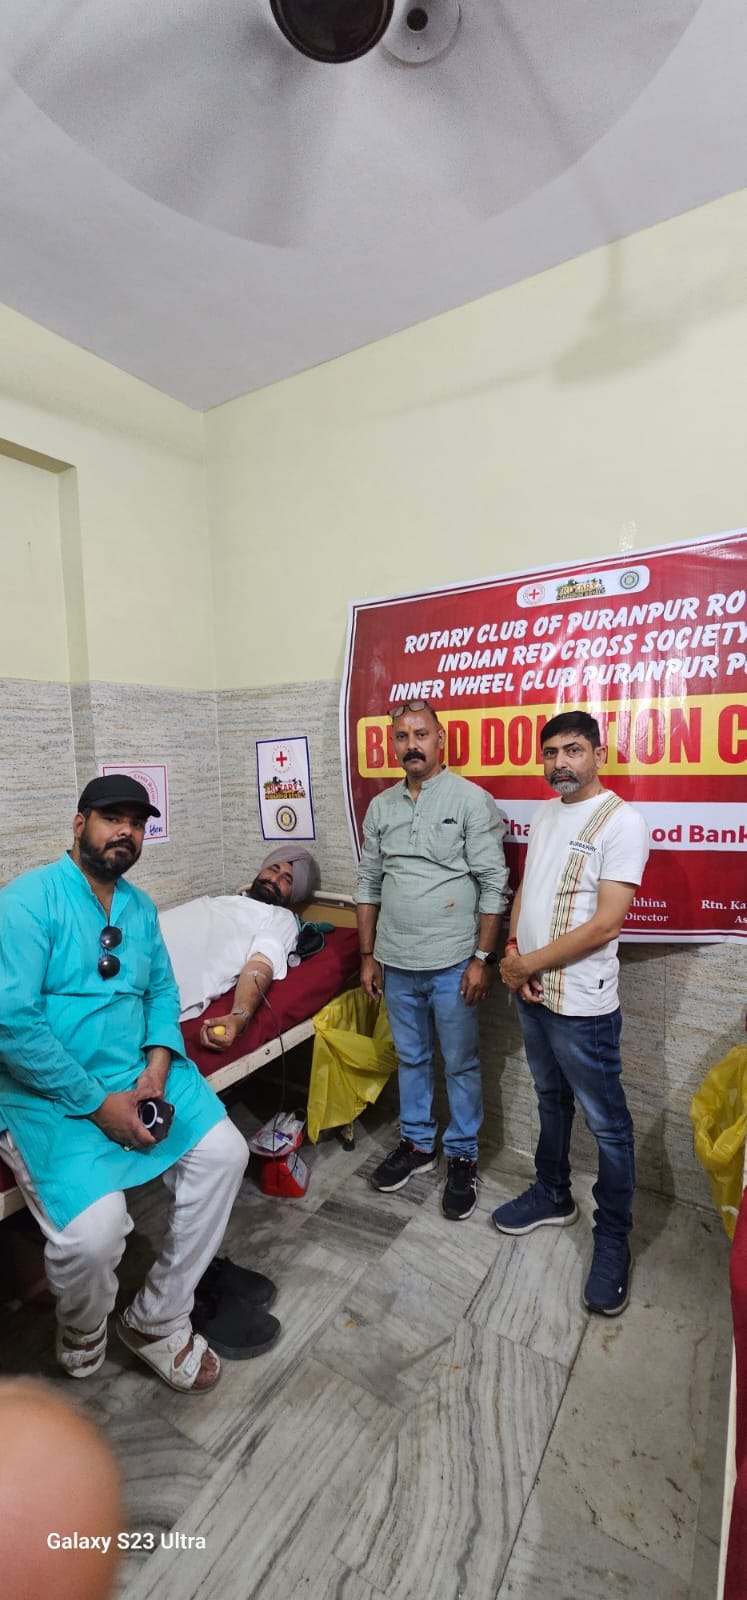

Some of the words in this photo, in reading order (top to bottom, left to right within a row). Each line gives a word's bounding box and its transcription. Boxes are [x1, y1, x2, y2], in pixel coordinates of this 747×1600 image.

[404, 627, 474, 654] ROTARY
[476, 619, 528, 644] CLUB
[533, 614, 563, 637] OF
[567, 597, 700, 635] PURANPUR
[437, 647, 508, 673] INDIAN
[511, 642, 557, 666] RED
[560, 633, 637, 661] CROSS
[640, 621, 747, 653] SOCIETY
[389, 679, 445, 702] INNER
[449, 673, 515, 696] WHEEL
[520, 667, 576, 691] CLUB
[582, 654, 719, 686] PURANPUR
[689, 825, 747, 844] Bank
[624, 912, 669, 922] Director
[630, 897, 667, 908] hhina
[701, 899, 727, 910] Rtn.
